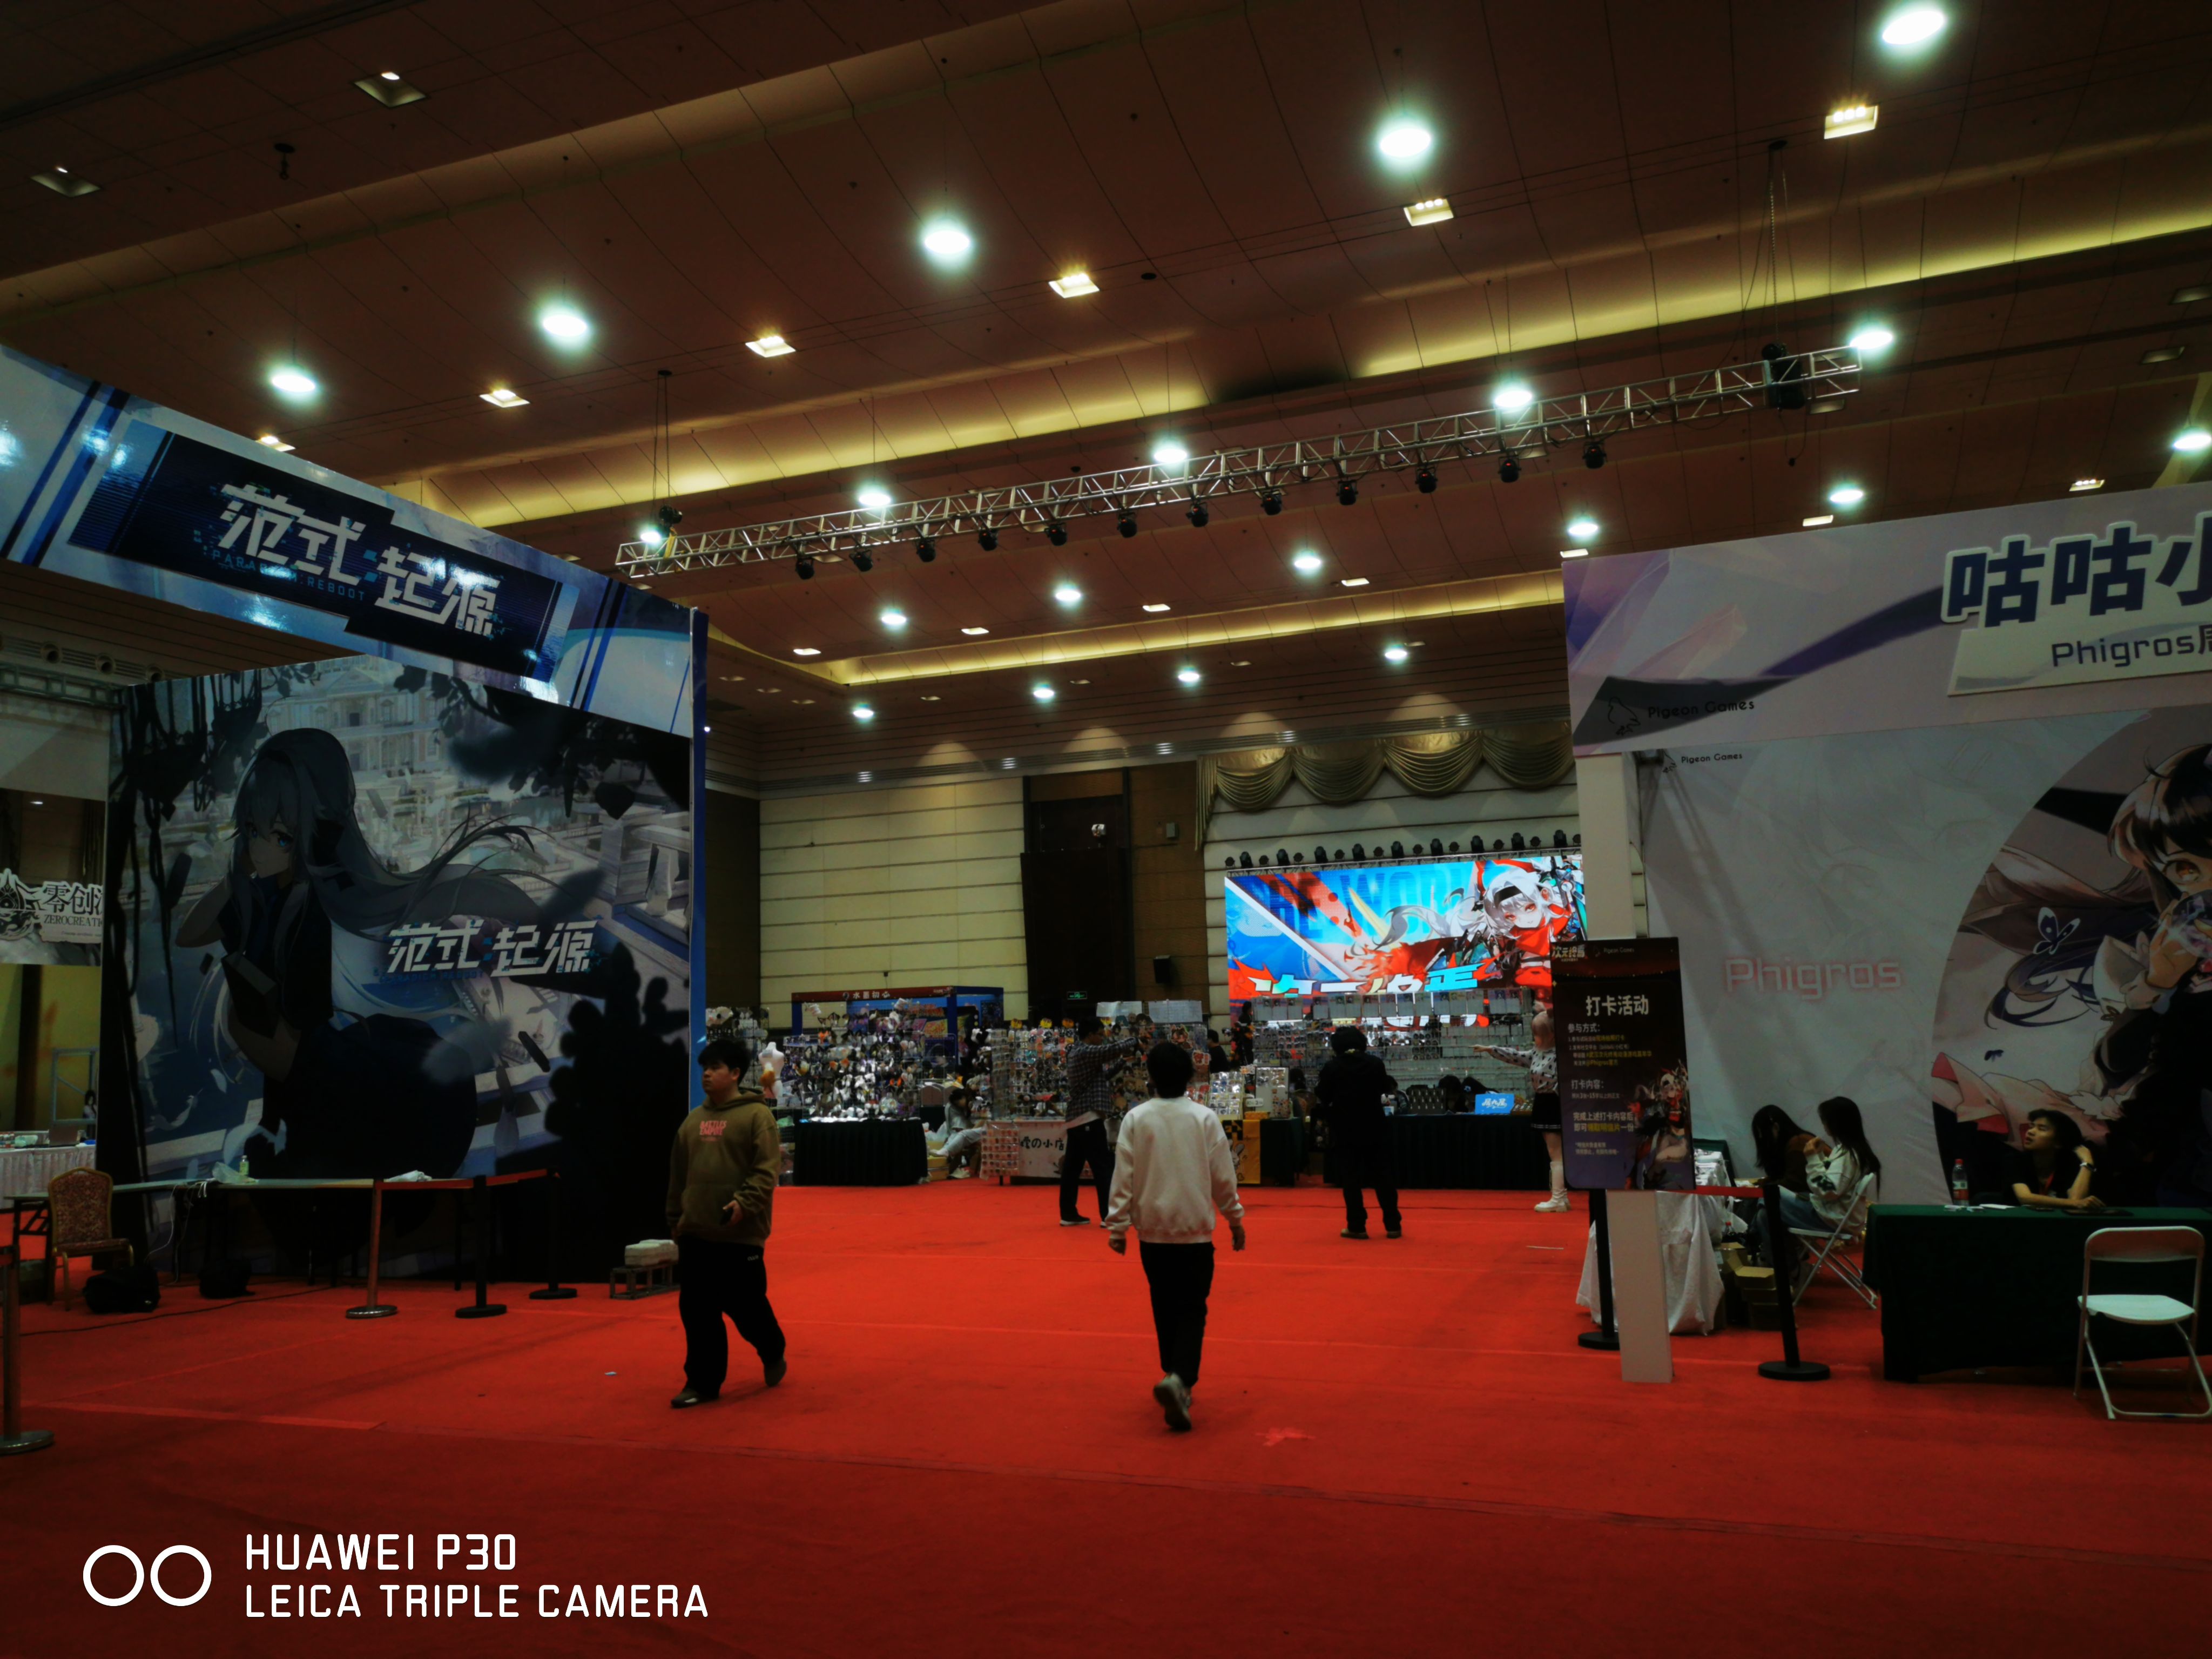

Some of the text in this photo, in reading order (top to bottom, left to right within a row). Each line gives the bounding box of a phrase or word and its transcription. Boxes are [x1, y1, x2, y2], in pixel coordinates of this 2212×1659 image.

[1648, 700, 1755, 719] Pigeon Games
[1681, 753, 1742, 764] Pigeon Games
[1725, 957, 1901, 1000] Phigros
[1586, 994, 1649, 1016] 打卡活动
